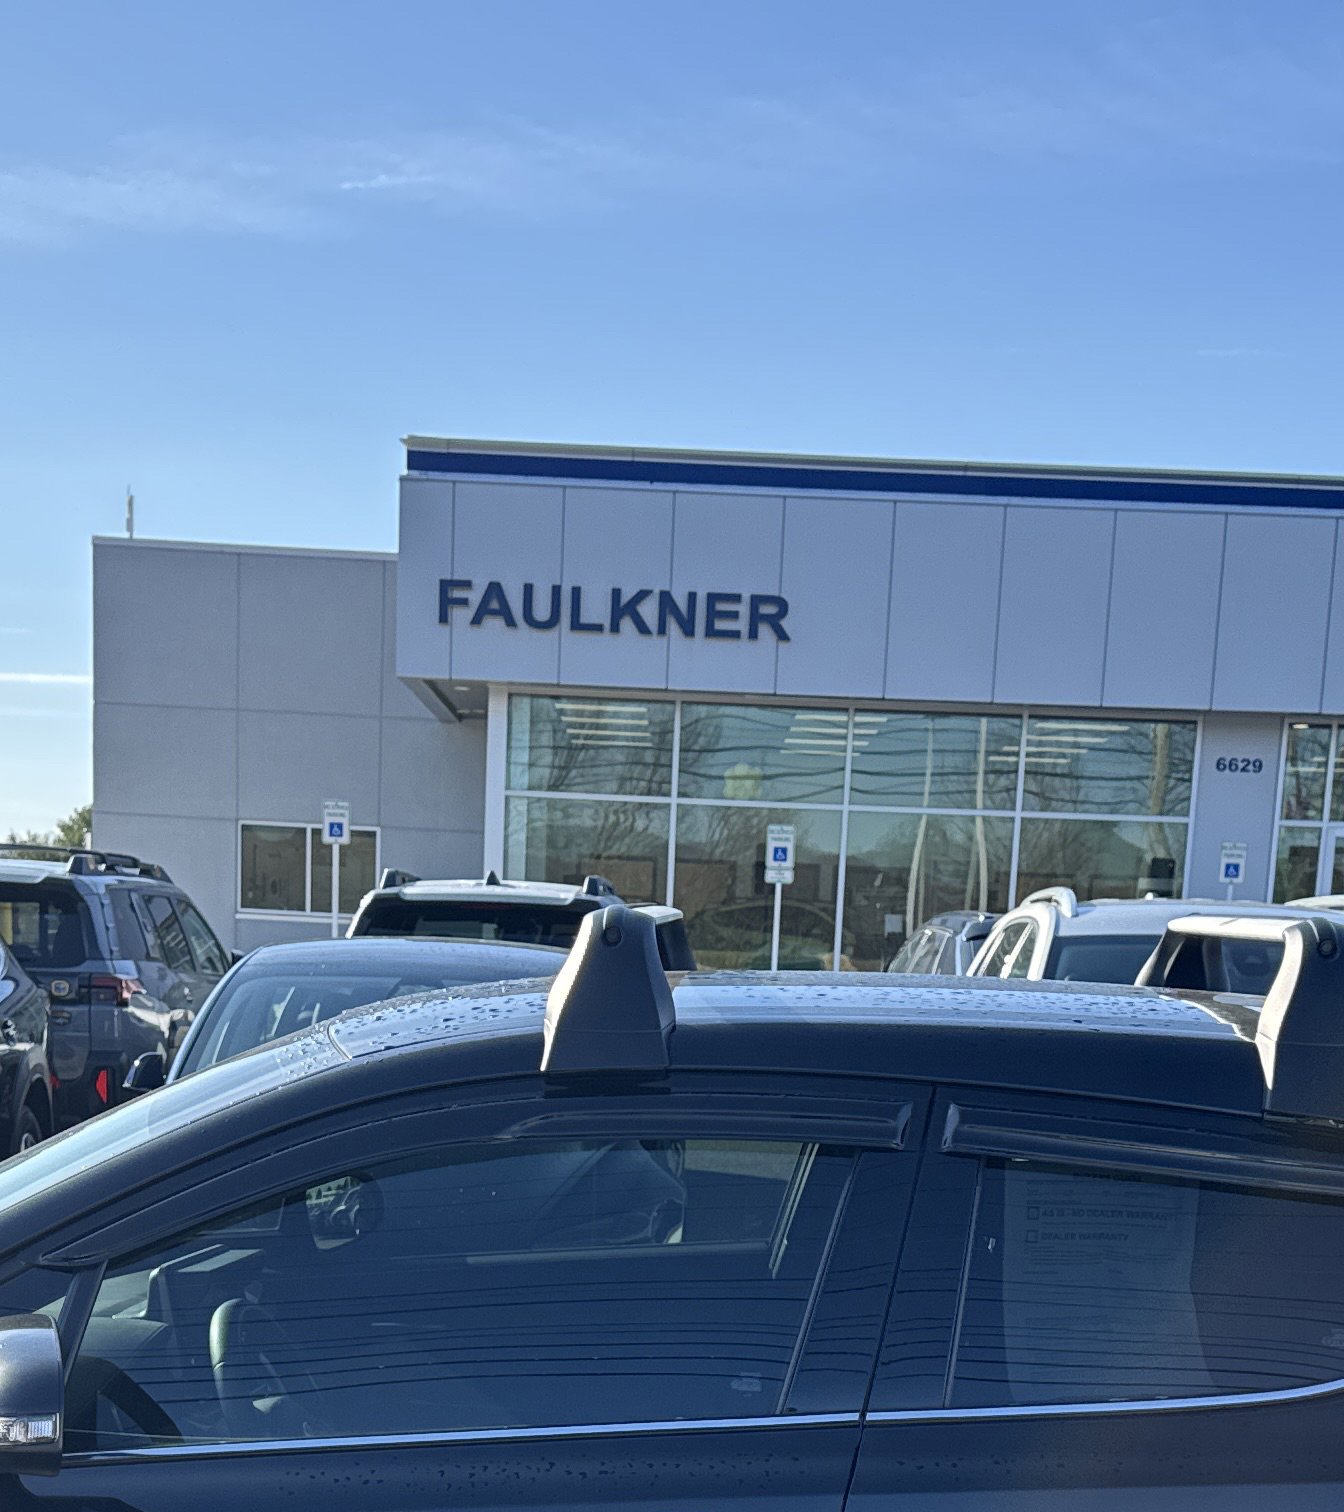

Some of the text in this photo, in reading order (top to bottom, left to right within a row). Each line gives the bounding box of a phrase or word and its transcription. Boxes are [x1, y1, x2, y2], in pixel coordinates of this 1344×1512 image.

[438, 579, 791, 642] FAULKNER
[1216, 757, 1263, 773] 6629
[1086, 1209, 1123, 1218] DEALER
[1041, 1231, 1129, 1242] DEALER WARRANTY
